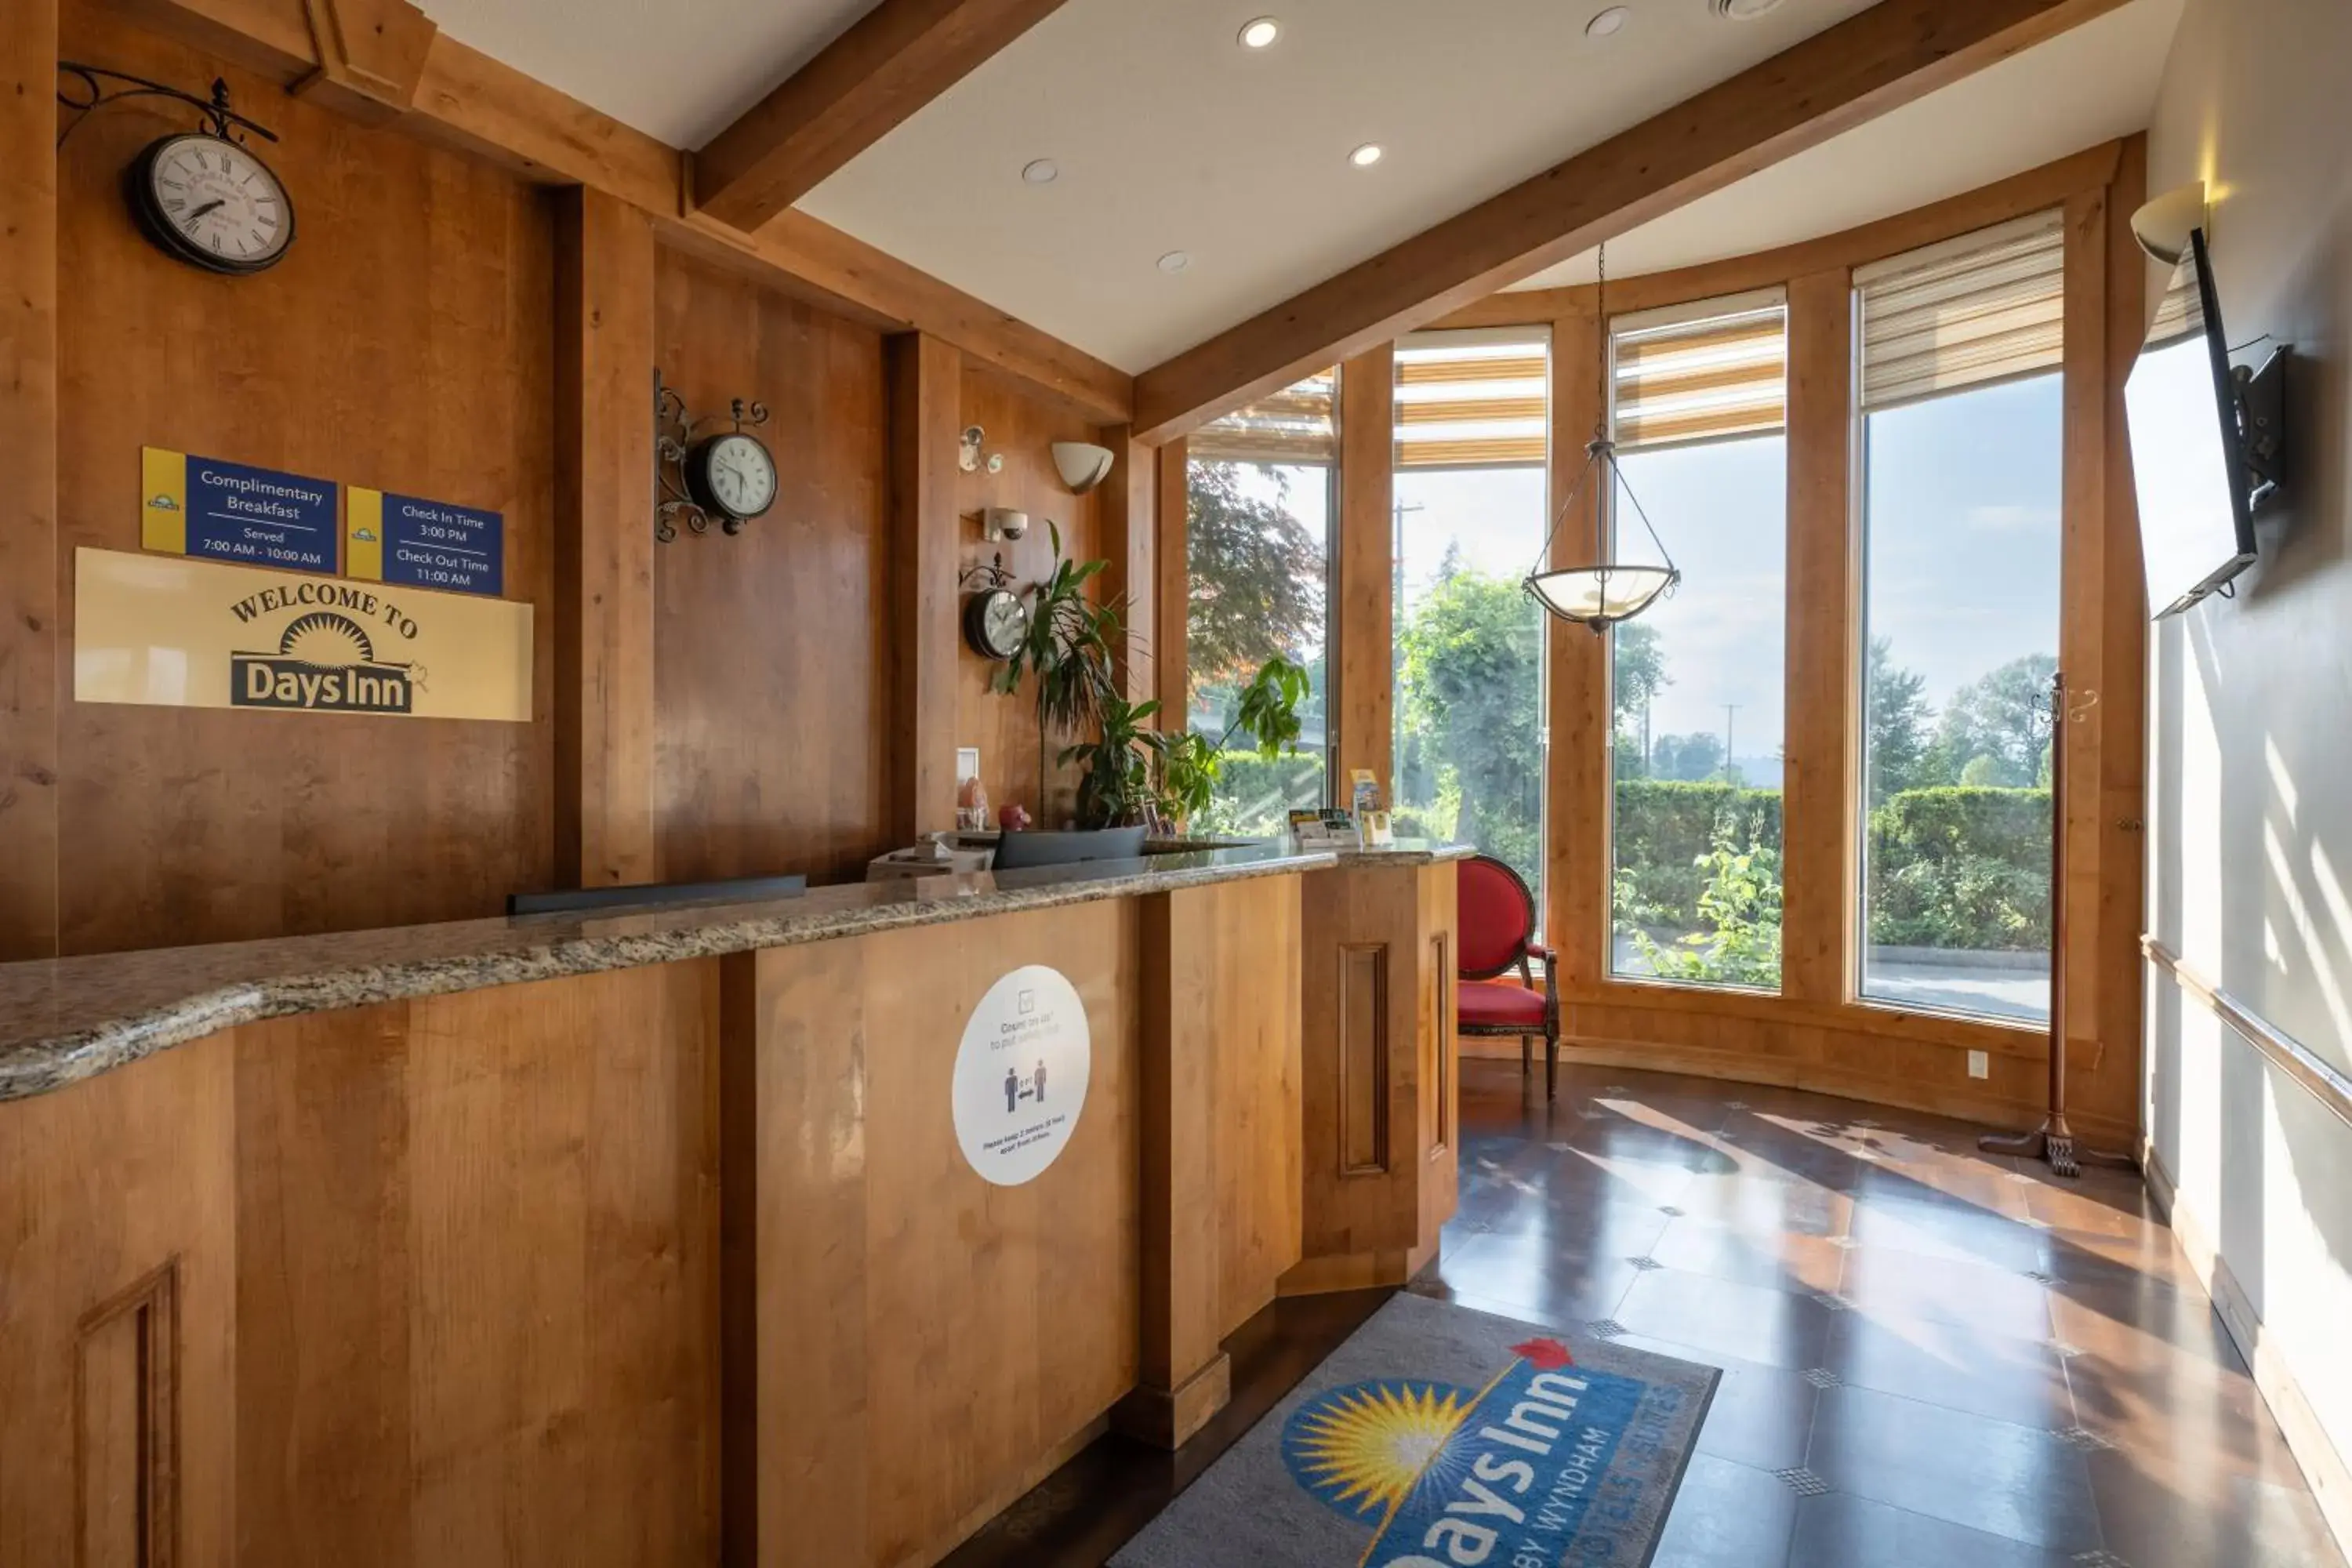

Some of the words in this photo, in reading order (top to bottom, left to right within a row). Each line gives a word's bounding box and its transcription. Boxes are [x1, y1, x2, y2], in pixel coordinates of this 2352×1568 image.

[201, 470, 322, 506] Complimentary
[227, 495, 300, 519] Breakfast
[402, 506, 438, 521] Check
[441, 512, 452, 524] In
[456, 514, 484, 529] Time
[244, 528, 285, 543] Served
[420, 524, 445, 539] 3:00
[448, 529, 466, 542] PM
[204, 539, 230, 552] 7:00
[234, 544, 255, 556] AM
[267, 548, 298, 561] 10:00
[301, 553, 321, 564] AM
[396, 549, 432, 564] Check
[436, 555, 457, 568] Out
[462, 558, 489, 572] Time
[417, 568, 448, 583] 11:00
[451, 573, 470, 586] AM
[230, 583, 379, 624] WELCOME
[384, 604, 419, 640] TO
[247, 663, 341, 708] Days
[347, 669, 405, 706] Inn
[1480, 1372, 1589, 1456] Inn
[1534, 1427, 1612, 1531] WYNDHAM
